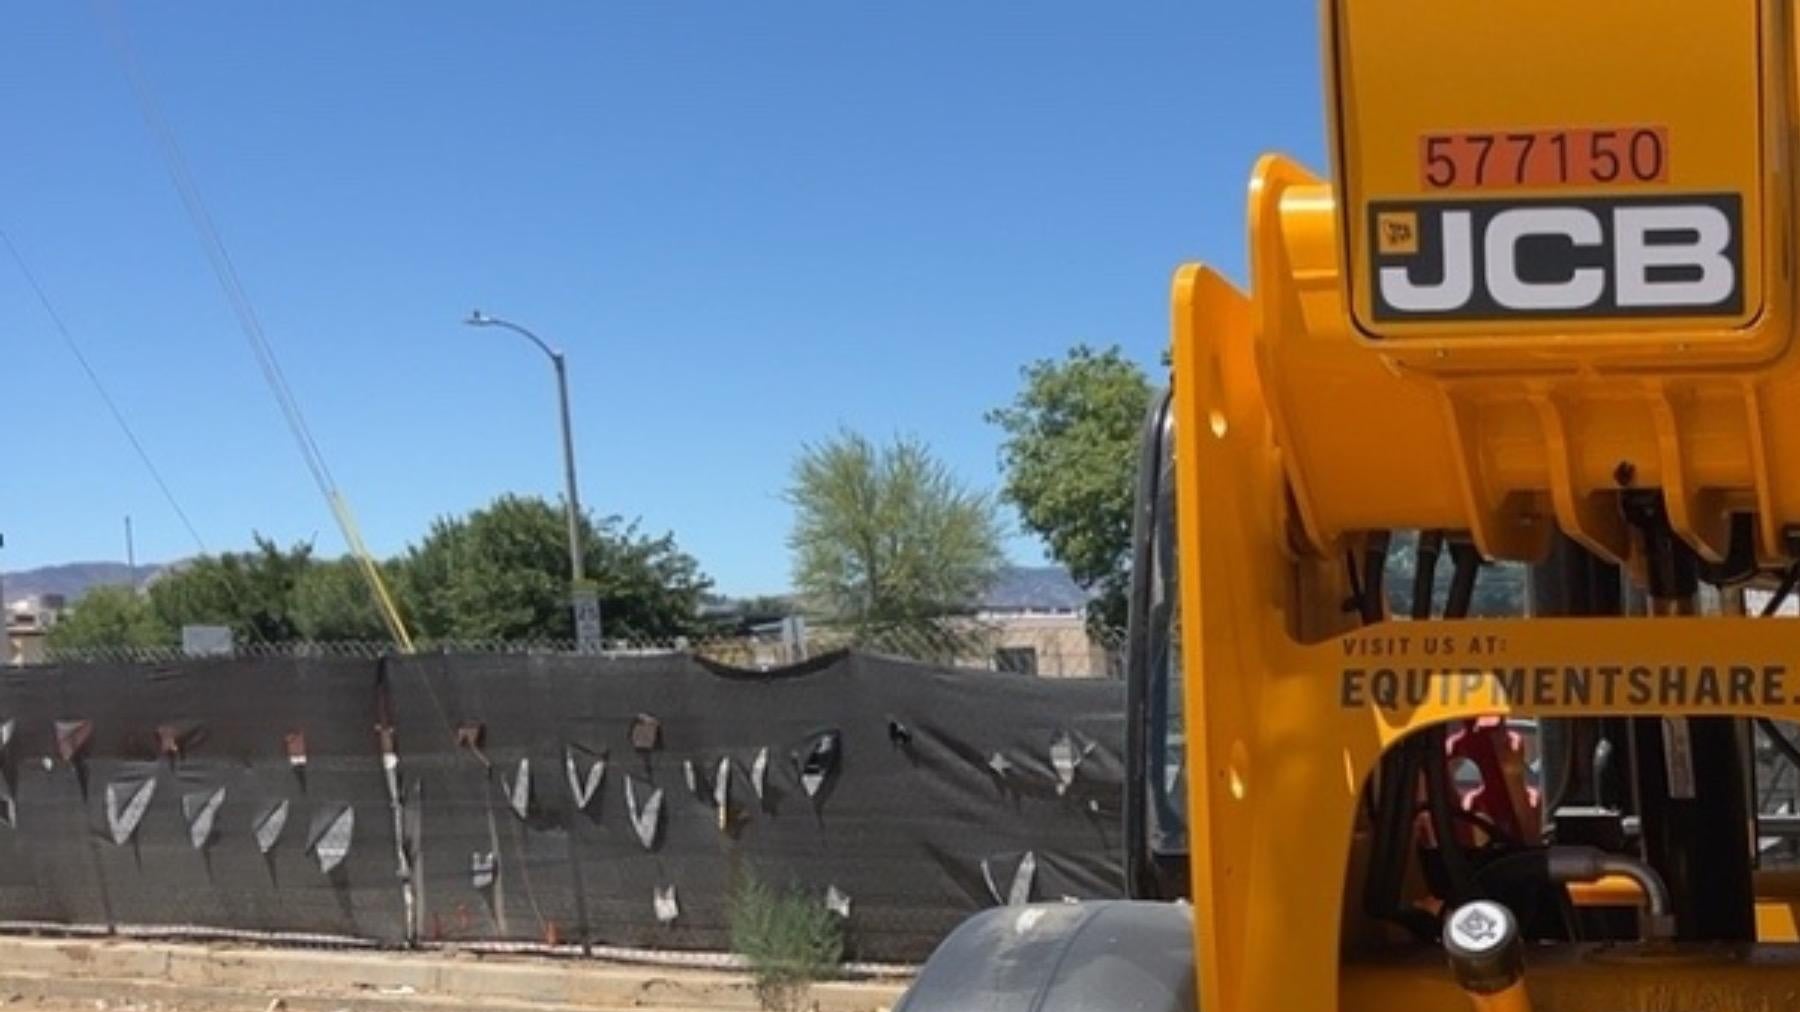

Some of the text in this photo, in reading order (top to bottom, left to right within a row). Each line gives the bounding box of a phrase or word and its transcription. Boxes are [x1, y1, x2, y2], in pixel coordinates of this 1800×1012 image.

[1426, 129, 1663, 188] 577150
[1379, 205, 1733, 311] JCB
[1342, 635, 1507, 656] VISIT US AT:
